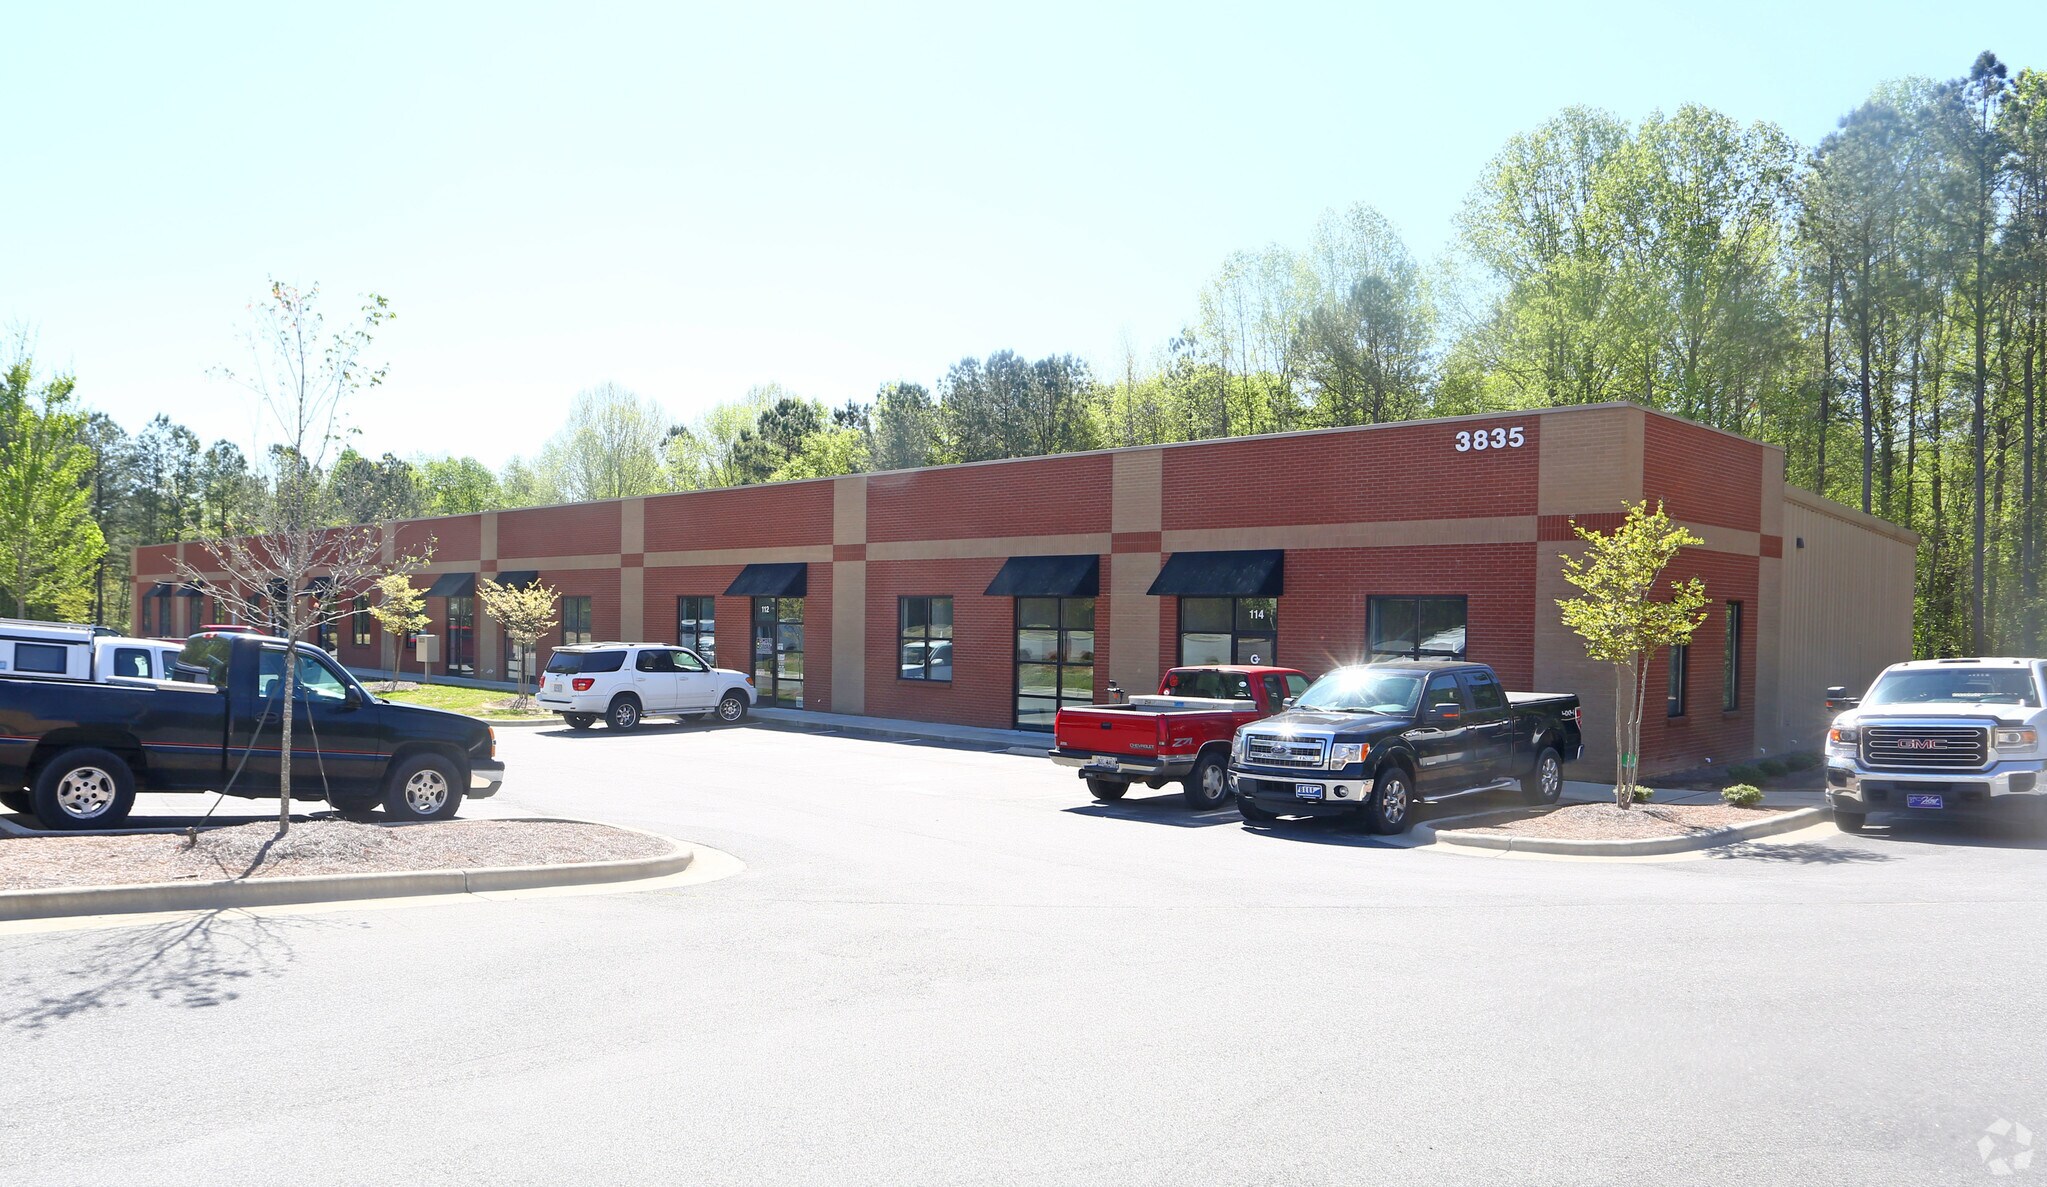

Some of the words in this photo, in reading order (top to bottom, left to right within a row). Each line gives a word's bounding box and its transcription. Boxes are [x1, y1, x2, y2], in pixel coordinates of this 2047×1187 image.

[1455, 426, 1525, 452] 3835
[761, 605, 770, 613] 112
[1249, 609, 1264, 619] 114
[1172, 737, 1193, 747] Z71
[1898, 739, 1947, 749] GMC
